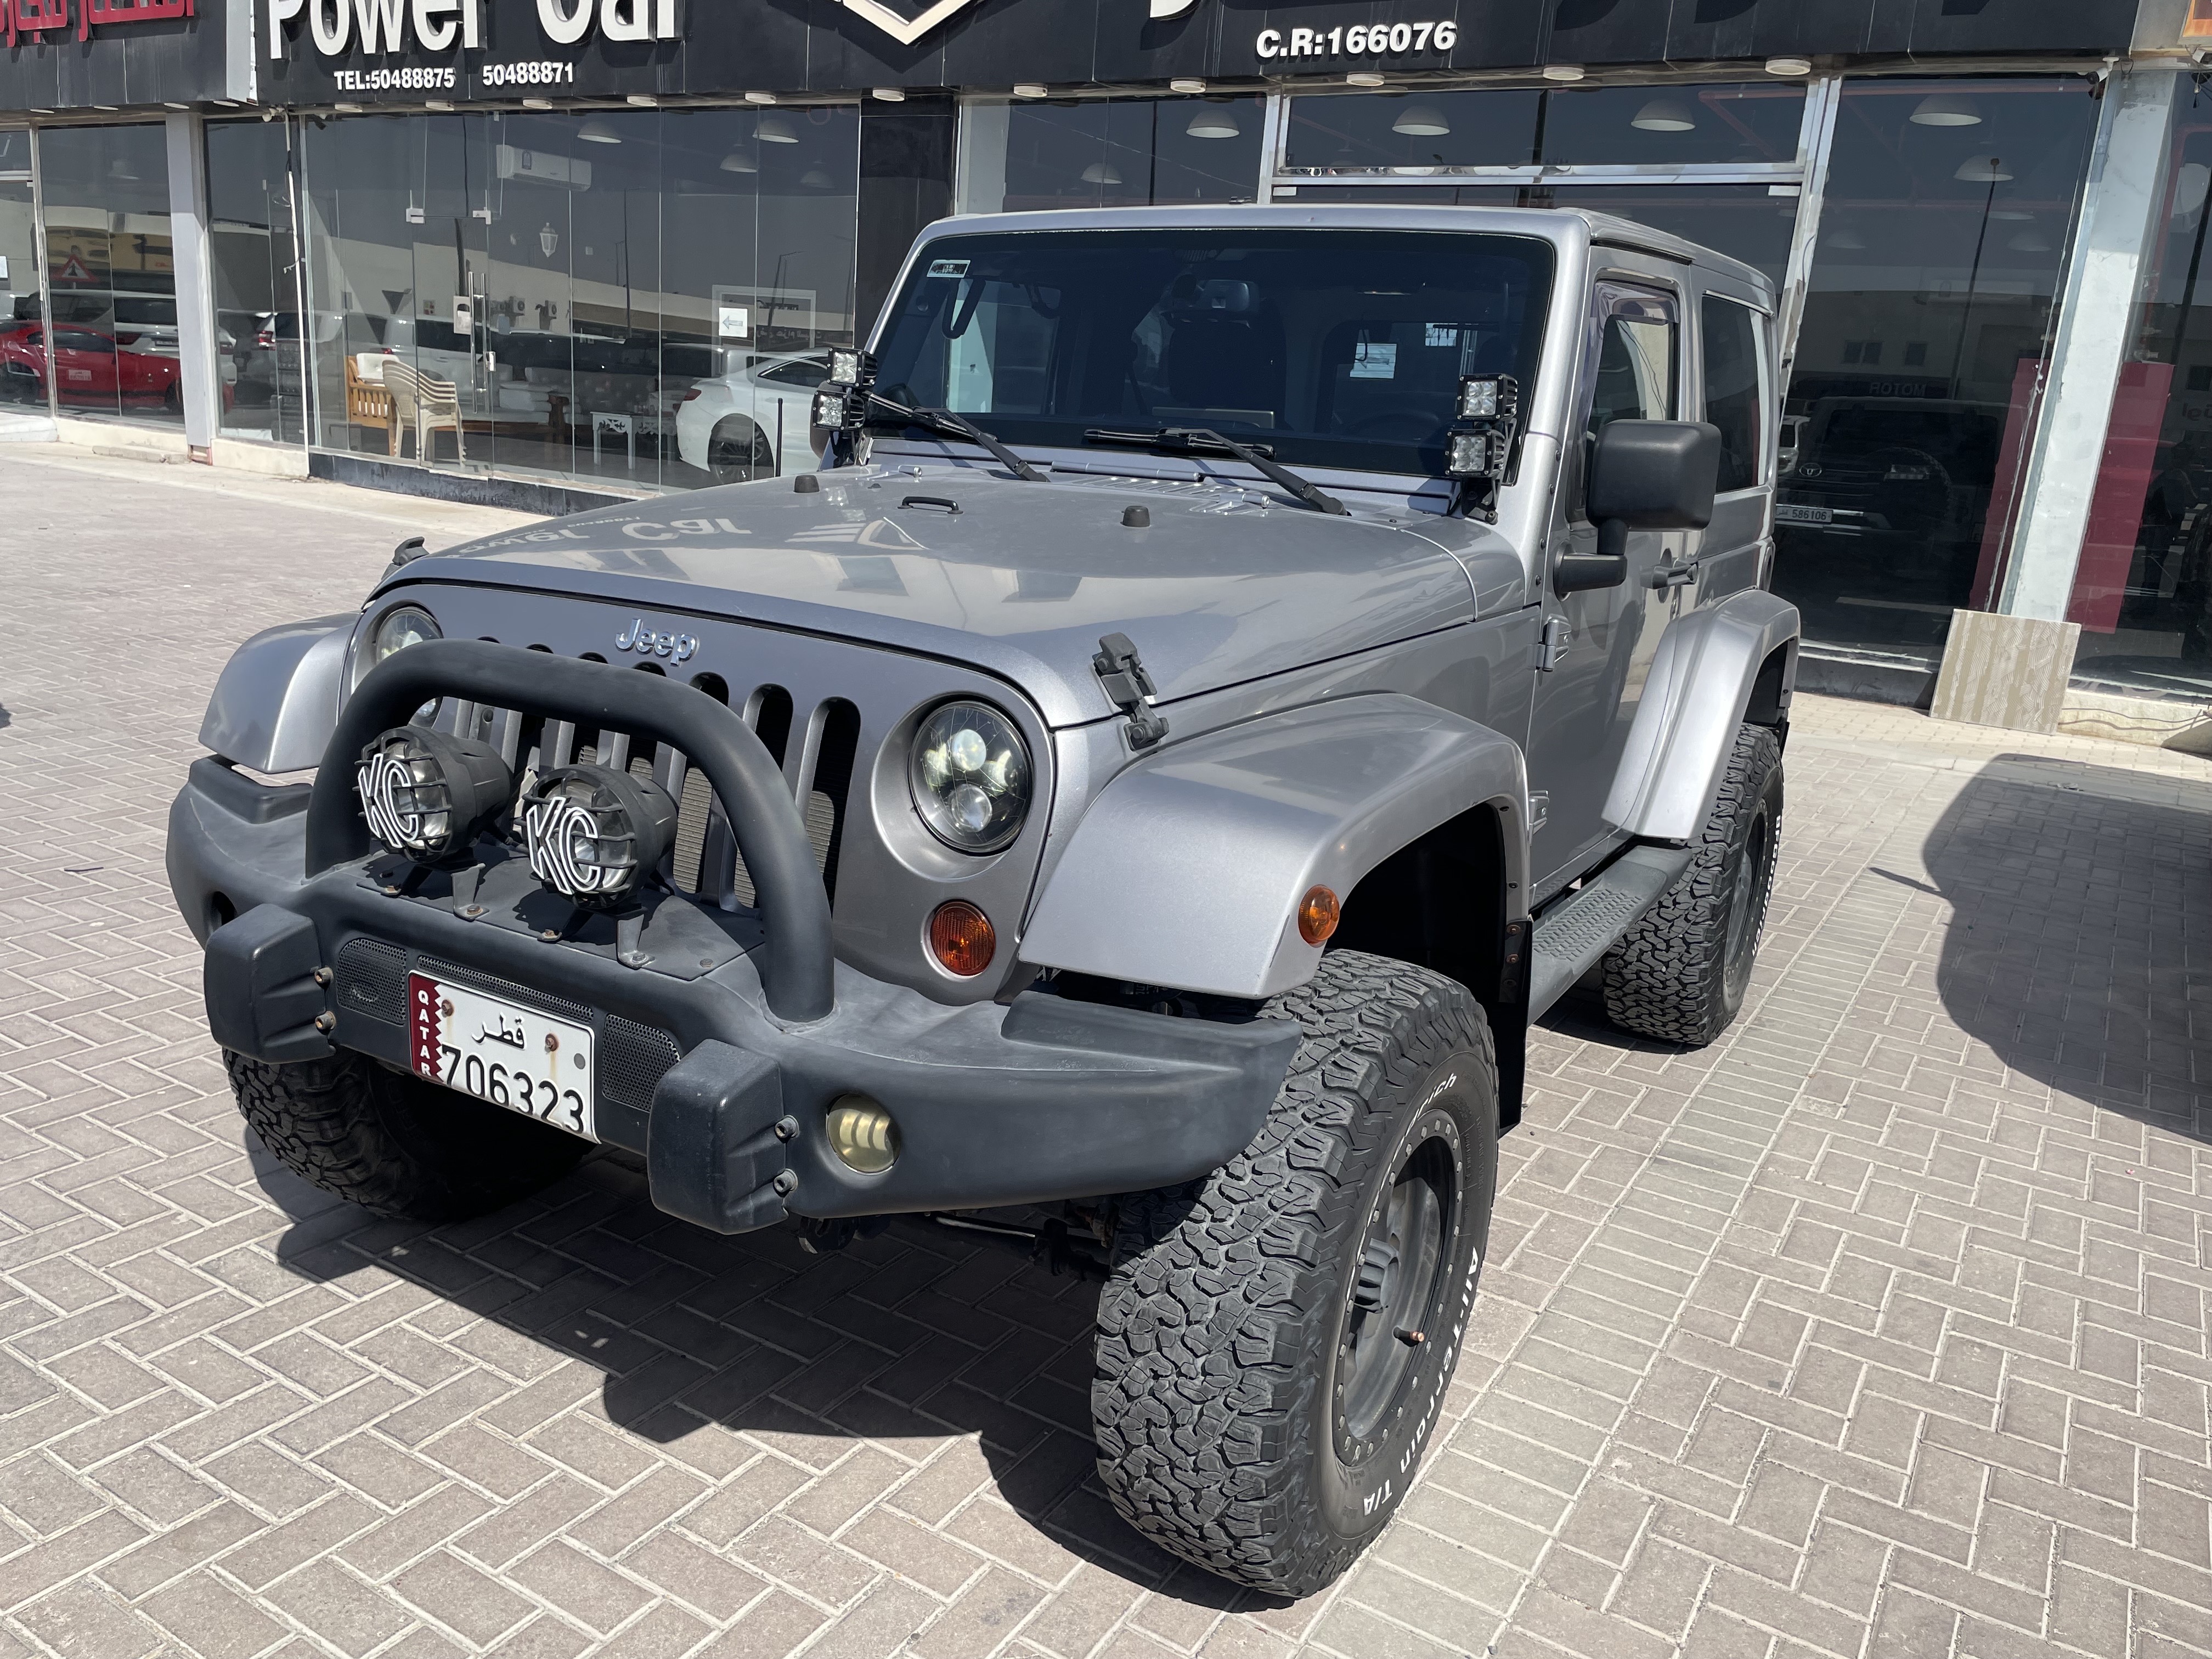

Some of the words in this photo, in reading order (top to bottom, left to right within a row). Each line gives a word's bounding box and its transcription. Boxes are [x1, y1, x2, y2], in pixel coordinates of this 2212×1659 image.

[1256, 21, 1457, 58] C.R:166076
[334, 67, 455, 91] TEL:50488875
[482, 62, 574, 86] 50488871
[1792, 509, 1827, 521] 586106
[615, 618, 700, 667] Jeep
[358, 753, 419, 849] KC
[526, 796, 602, 895] KC
[418, 990, 432, 1077] QATAR
[471, 1012, 527, 1051] قطر
[441, 1042, 586, 1135] 706323
[1363, 1479, 1392, 1516] T/A
